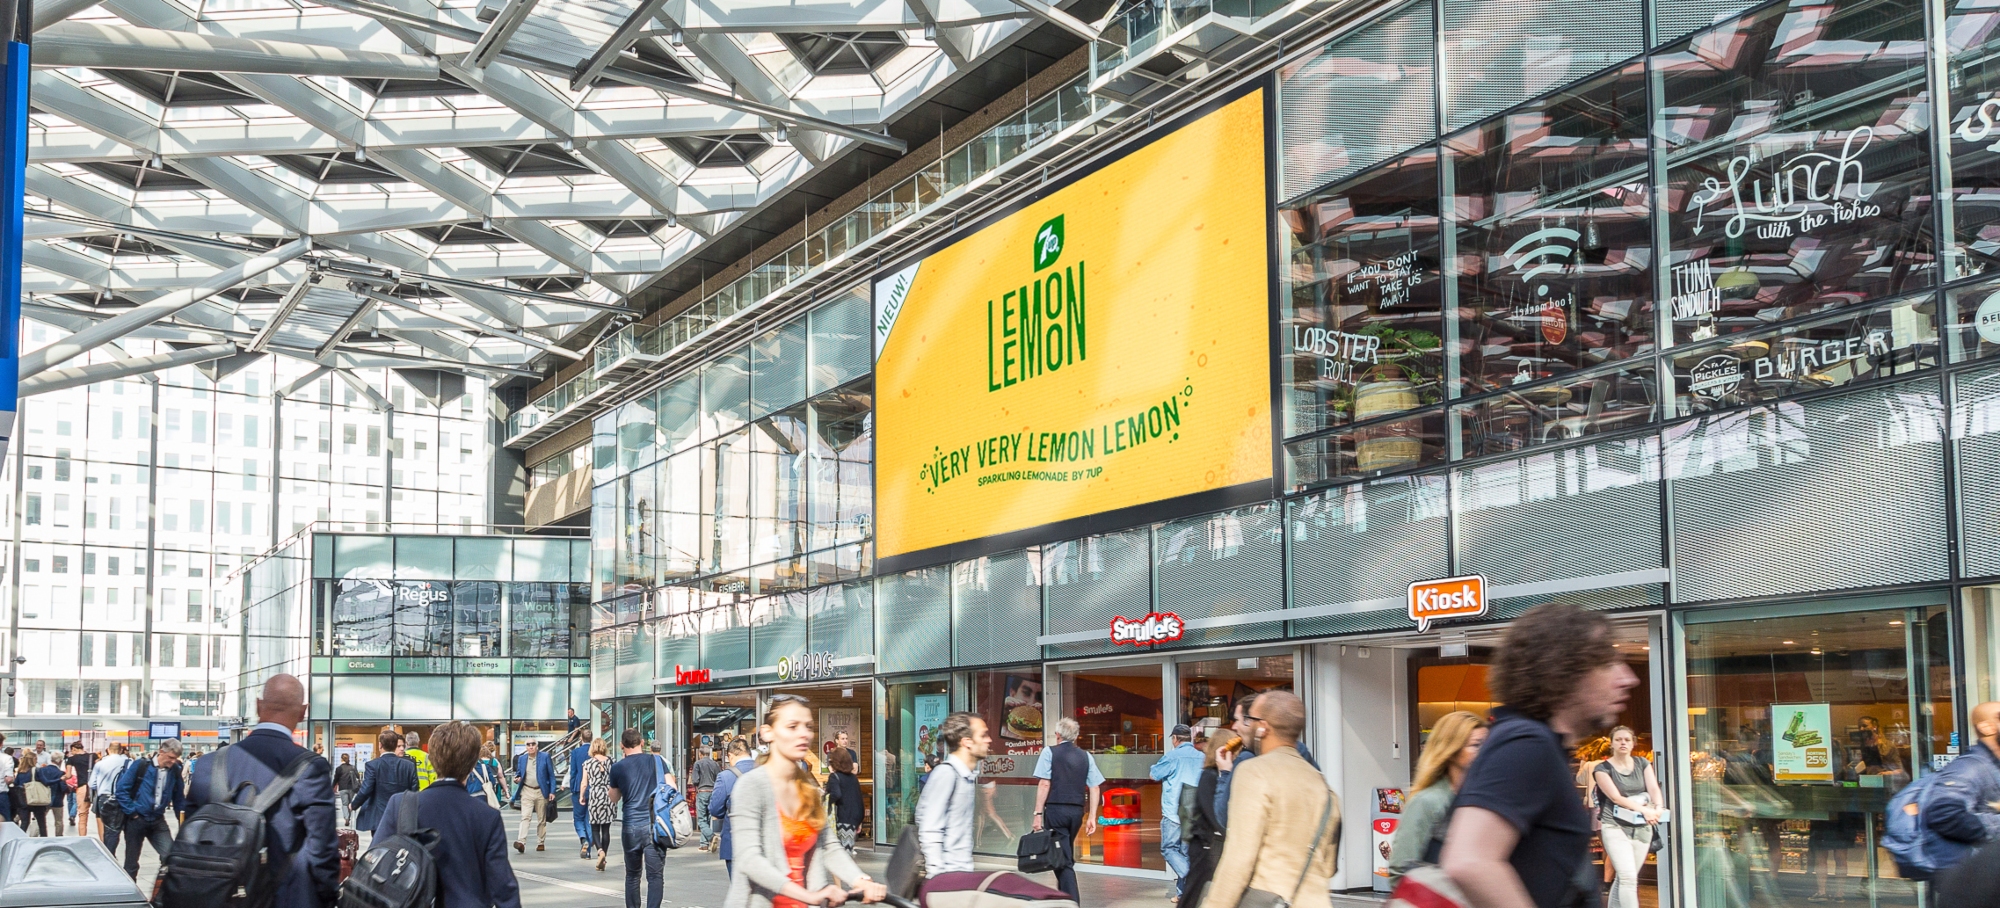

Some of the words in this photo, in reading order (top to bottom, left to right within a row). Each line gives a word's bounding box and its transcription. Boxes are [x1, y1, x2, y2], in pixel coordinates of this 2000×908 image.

[1703, 126, 1873, 238] Lunch
[1799, 214, 1828, 233] the
[1347, 271, 1357, 284] IF
[1361, 263, 1381, 279] YOU
[1387, 250, 1418, 271] DON'T
[1671, 258, 1713, 296] TUNA
[1347, 280, 1370, 294] WANT
[1375, 275, 1387, 285] TO
[1380, 280, 1402, 295] TAKE
[1407, 273, 1422, 286] US
[877, 273, 908, 336] NIEUW!
[1380, 287, 1410, 309] AWAY!
[1671, 287, 1721, 321] SANDWICH
[1294, 325, 1380, 364] LOBSTER
[1323, 358, 1356, 386] ROLL
[1695, 366, 1737, 382] PICKLES
[929, 445, 970, 488] VERY
[977, 432, 1021, 468] VERY
[1027, 428, 1094, 463] LEMON
[1103, 395, 1180, 455] LEMON
[978, 470, 1021, 487] SPARKLING
[1022, 470, 1068, 481] LEMONADE
[1072, 470, 1084, 481] BY
[1086, 466, 1103, 479] 7UP
[399, 586, 448, 607] Regus
[525, 601, 558, 612] Work.
[1416, 584, 1478, 612] Kiosk
[515, 614, 567, 624] Connect.
[1113, 616, 1180, 641] Smullers
[466, 661, 499, 669] Meetings
[676, 664, 710, 686] bruna
[802, 651, 833, 678] PLACE
[1083, 704, 1113, 714] Smullers
[982, 758, 1015, 774] Smullers
[1806, 756, 1828, 765] 25%
